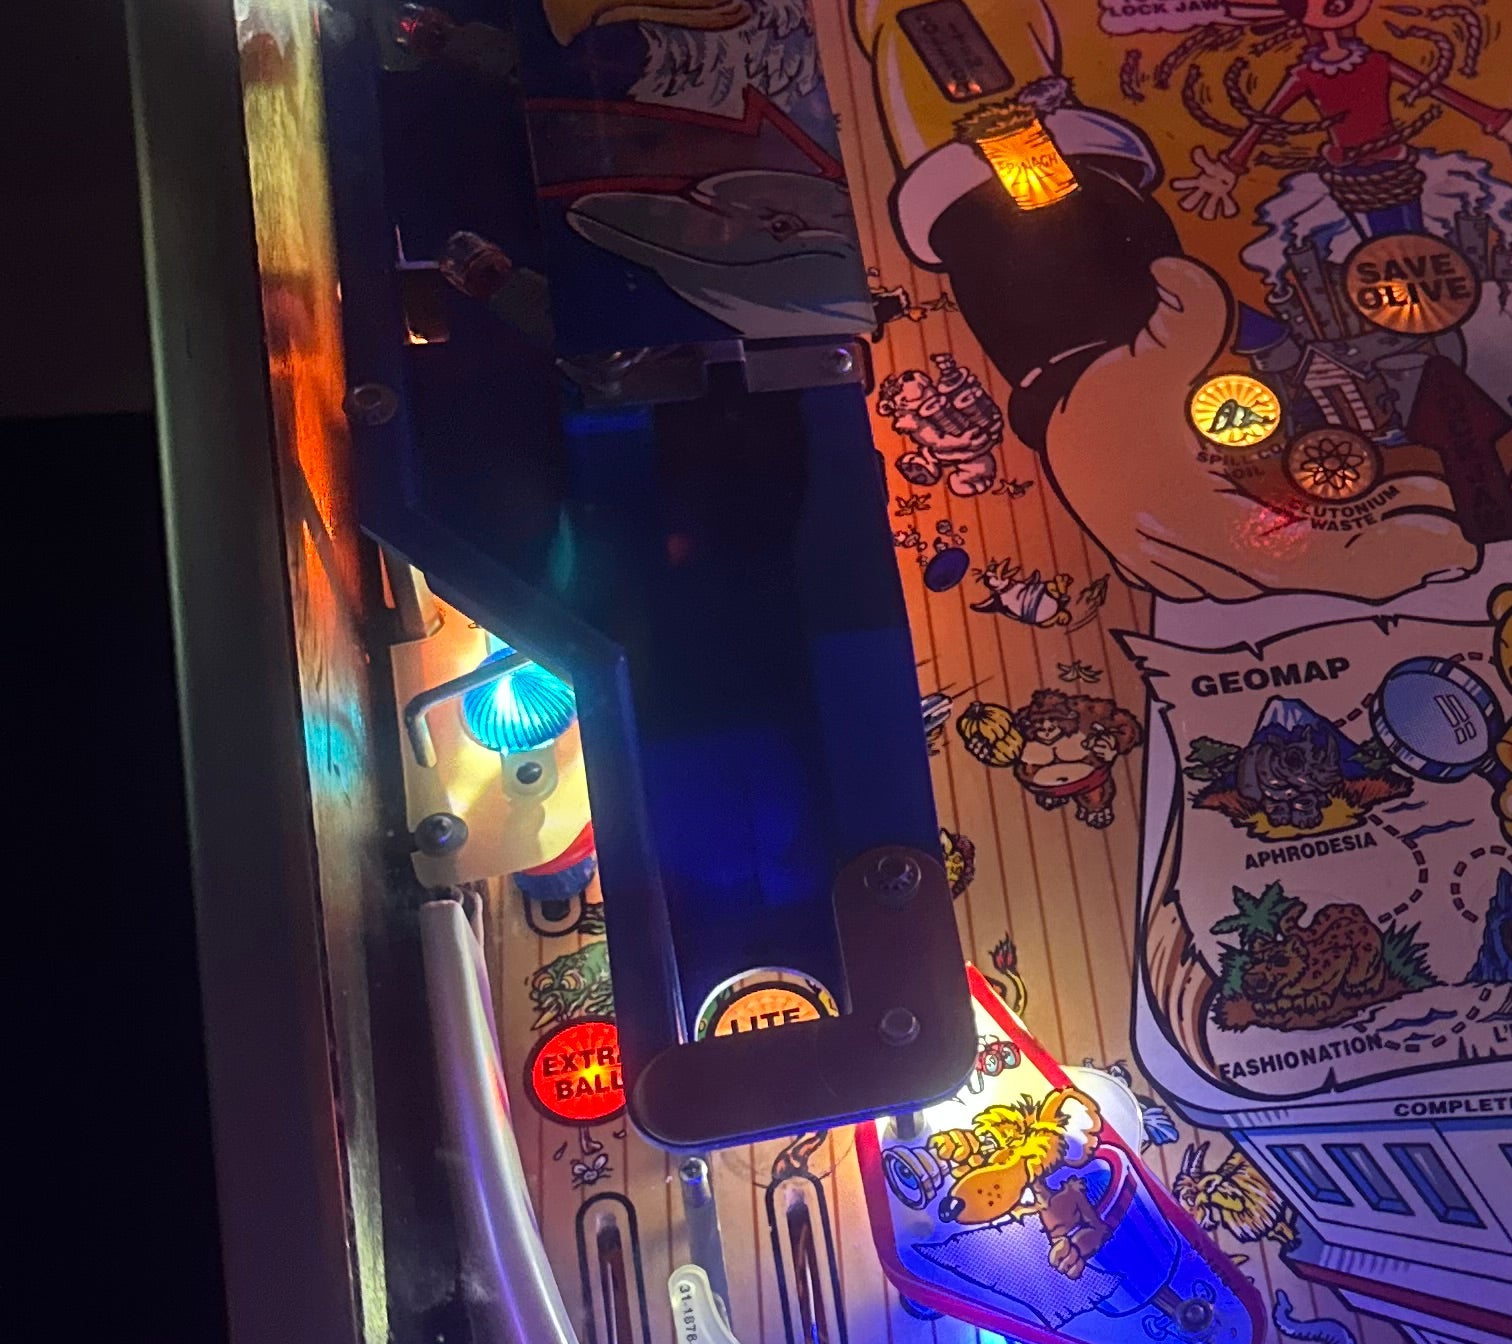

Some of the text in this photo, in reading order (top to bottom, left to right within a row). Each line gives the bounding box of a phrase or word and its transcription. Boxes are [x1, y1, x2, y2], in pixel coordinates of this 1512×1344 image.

[1109, 0, 1221, 17] LOCK JAW
[1357, 253, 1457, 284] SAVE
[1358, 276, 1473, 311] OLIVE
[1310, 513, 1378, 532] WASTE
[1191, 657, 1351, 698] GEOMAP
[1245, 832, 1378, 870] APHRODESIA
[542, 1046, 622, 1078] EXTR
[1218, 1032, 1384, 1080] FASHIONATION
